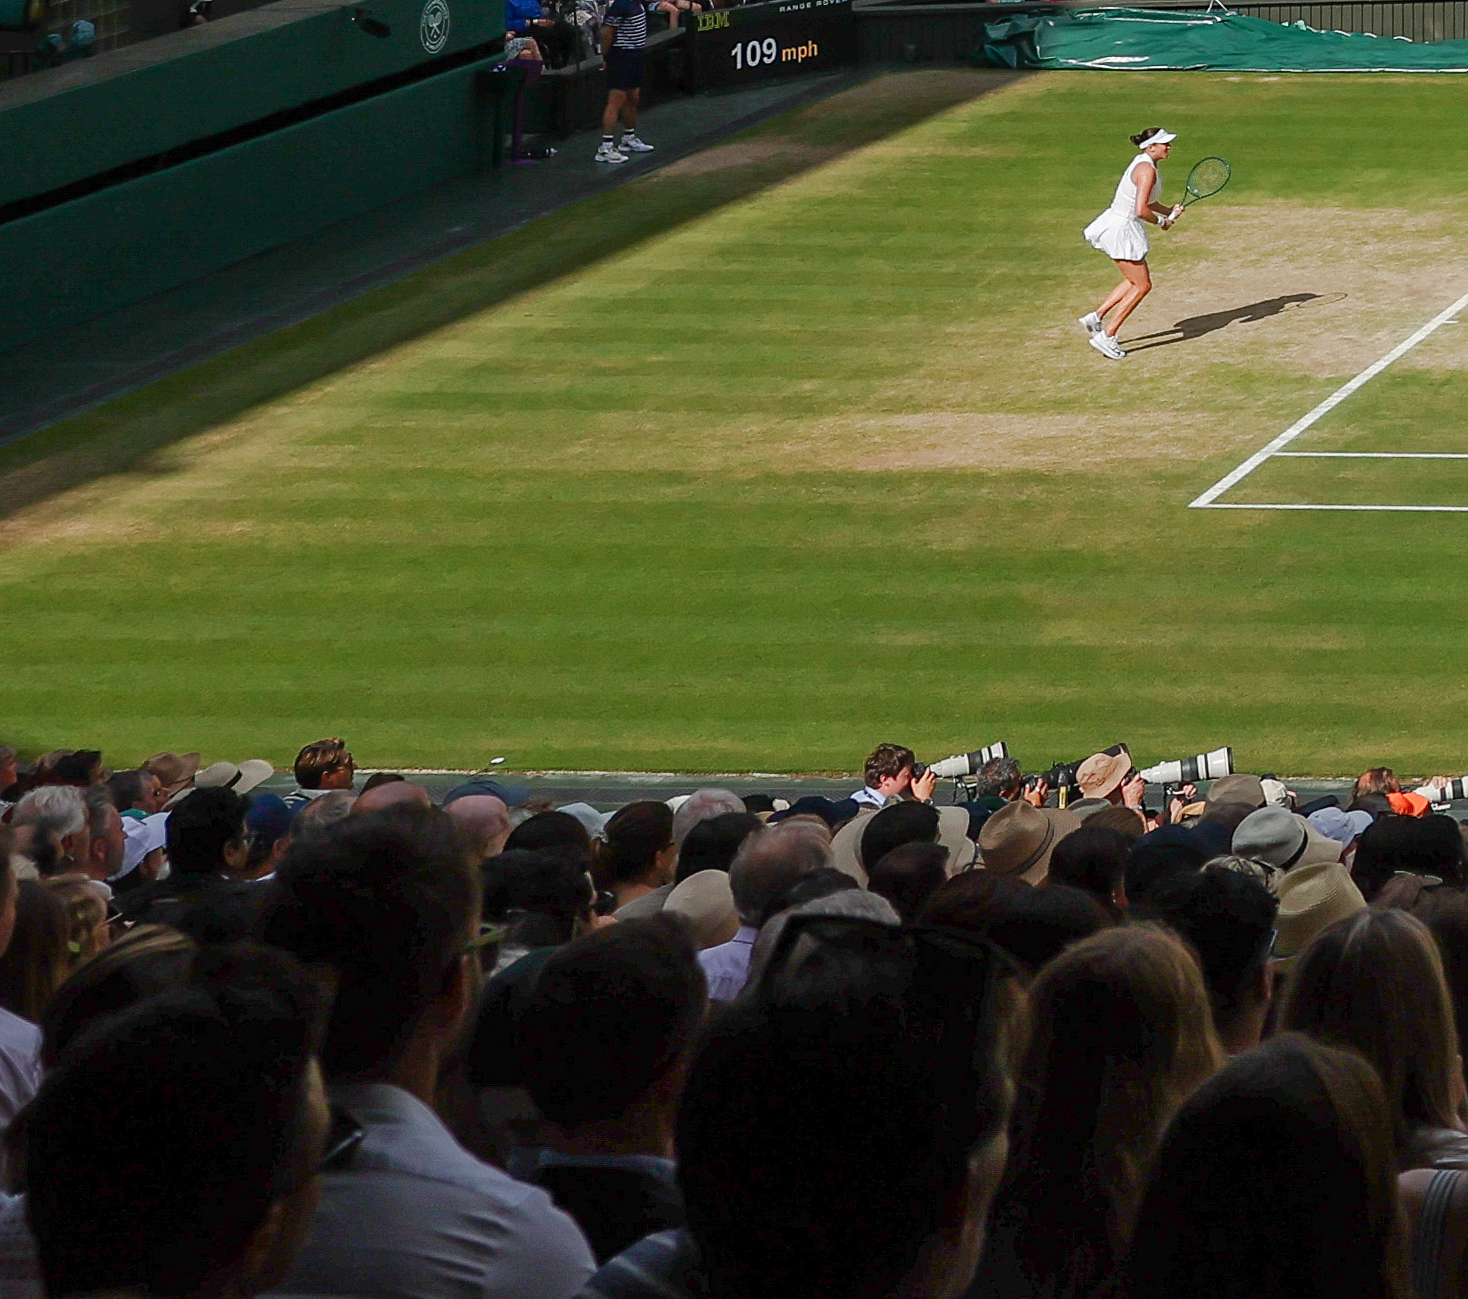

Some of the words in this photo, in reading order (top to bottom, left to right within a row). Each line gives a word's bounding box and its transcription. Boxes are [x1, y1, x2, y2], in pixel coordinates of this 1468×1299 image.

[780, 1, 812, 13] RANGE
[698, 11, 730, 32] IBM
[731, 37, 778, 70] 109
[782, 40, 818, 63] mph
